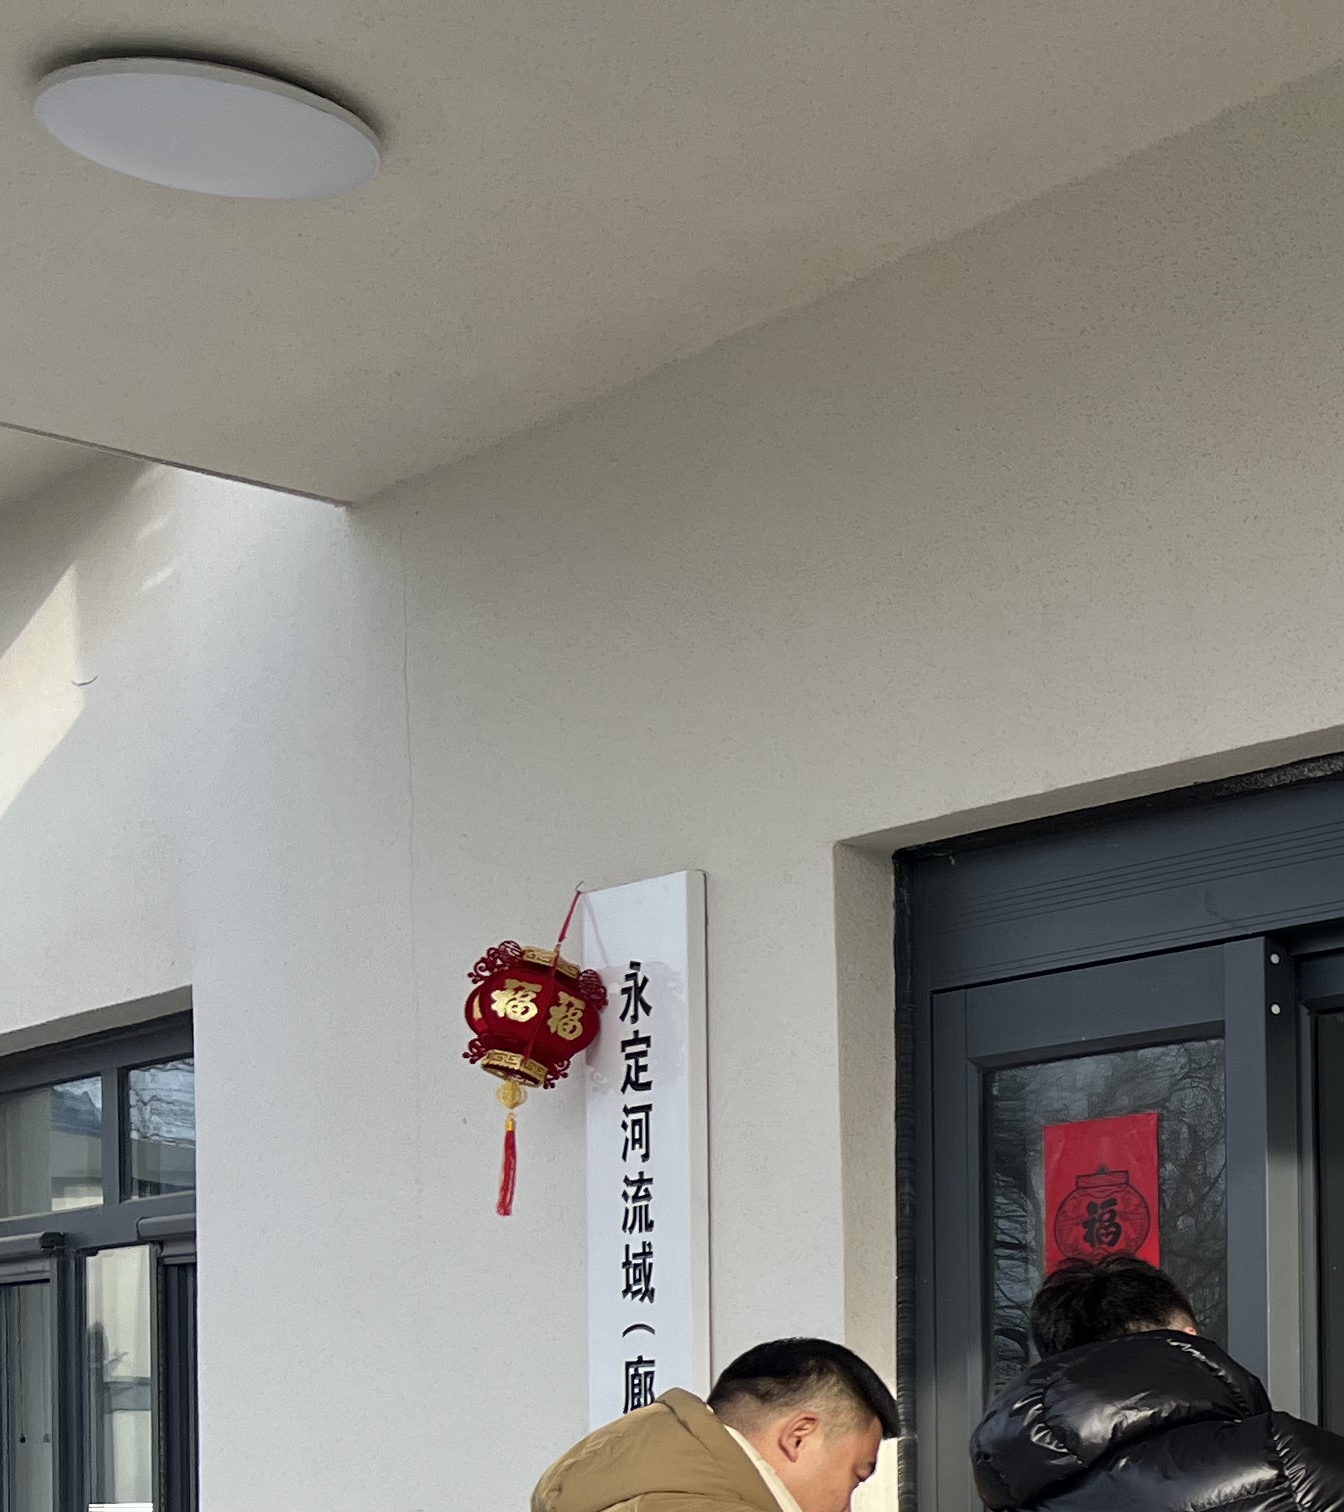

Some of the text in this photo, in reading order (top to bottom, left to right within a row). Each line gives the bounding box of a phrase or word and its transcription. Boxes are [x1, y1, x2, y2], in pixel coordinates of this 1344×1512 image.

[490, 979, 543, 1023] 福
[546, 991, 586, 1041] 福
[1082, 1198, 1123, 1248] 福
